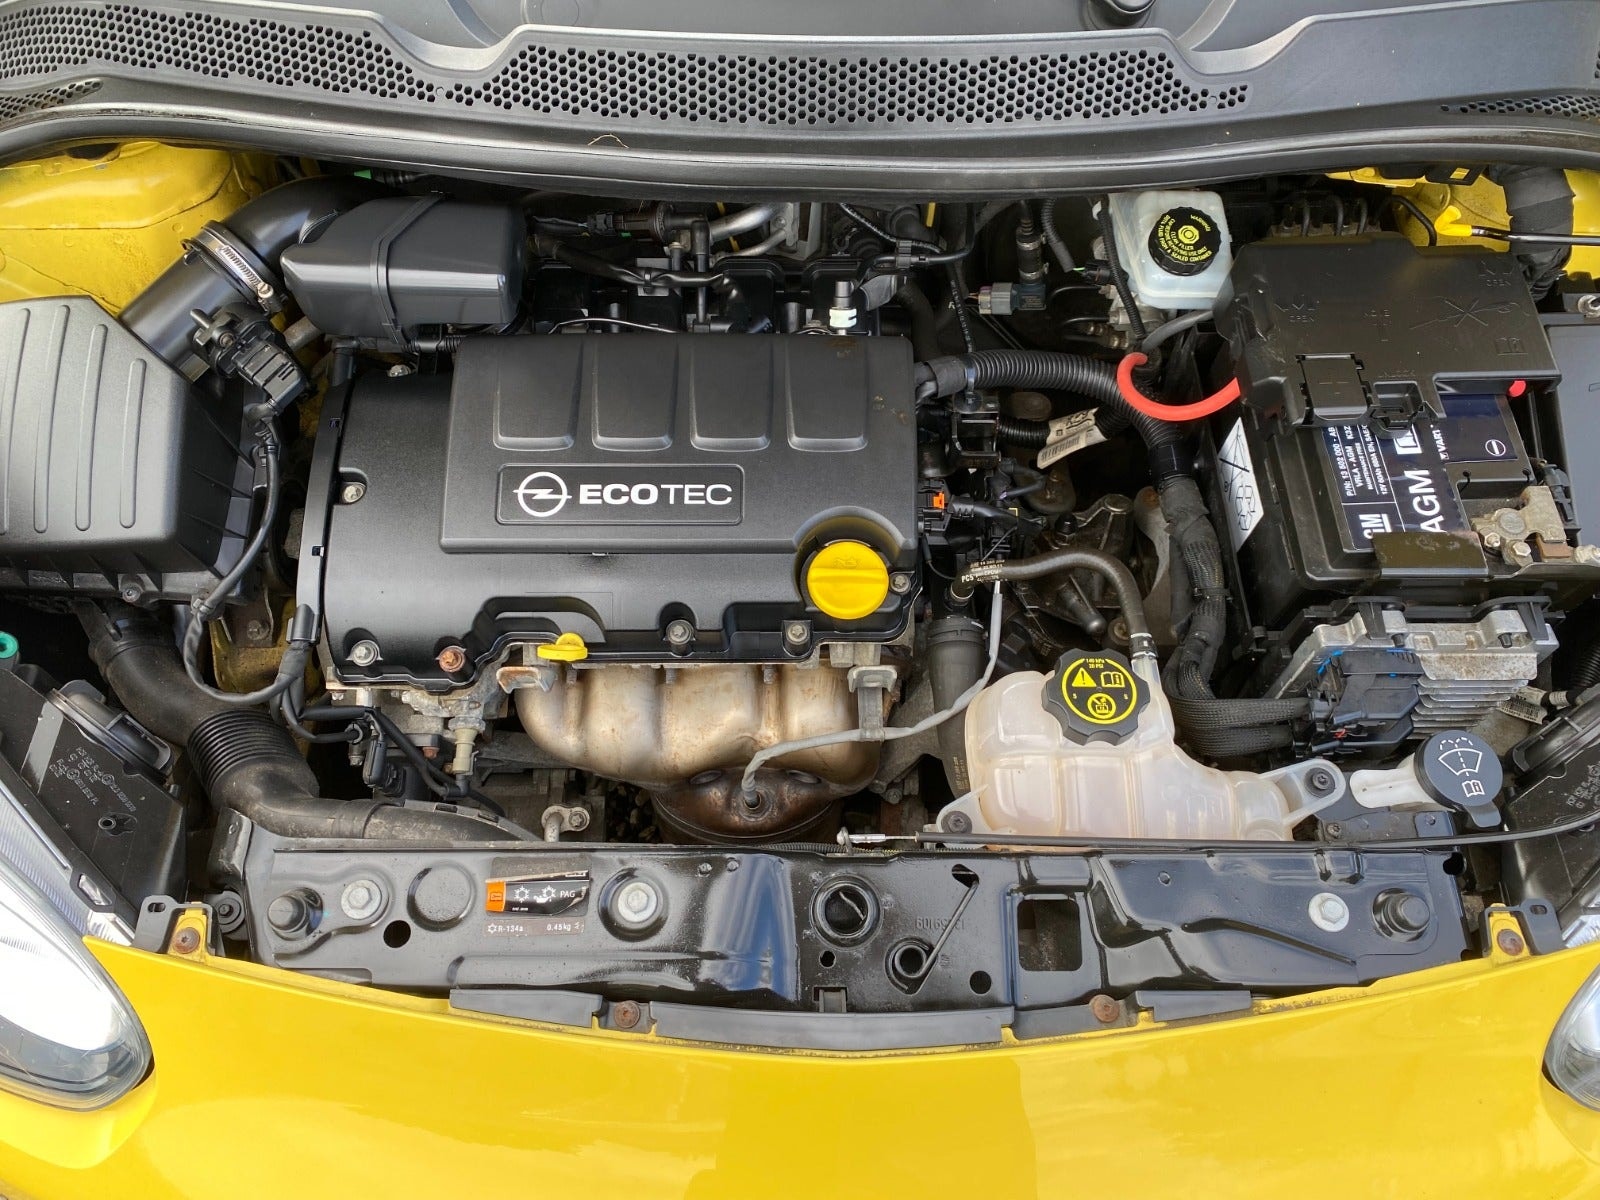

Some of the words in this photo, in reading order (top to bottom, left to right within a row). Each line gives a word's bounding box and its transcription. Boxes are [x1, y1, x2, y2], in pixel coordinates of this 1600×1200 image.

[1190, 214, 1211, 231] WARNING
[1171, 252, 1188, 262] SEALED
[579, 482, 733, 506] ECOTEC
[1403, 469, 1447, 533] AGM
[559, 890, 576, 899] PAG
